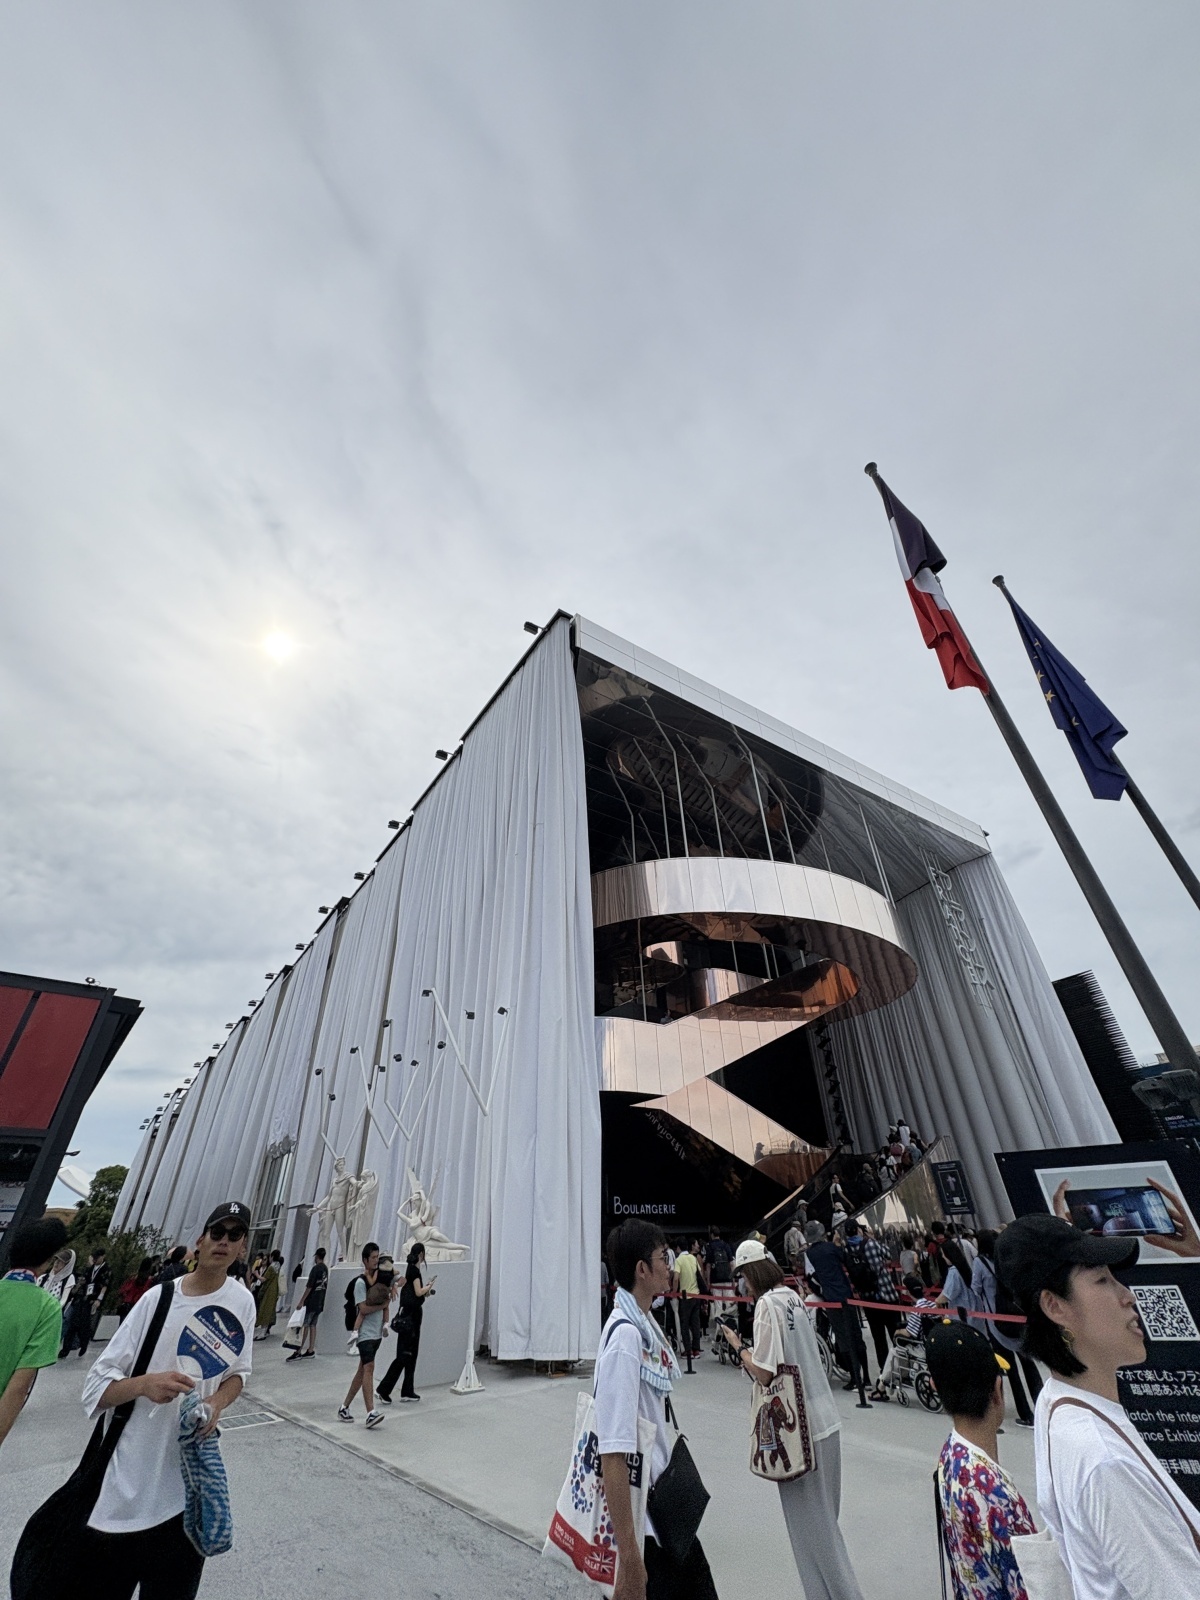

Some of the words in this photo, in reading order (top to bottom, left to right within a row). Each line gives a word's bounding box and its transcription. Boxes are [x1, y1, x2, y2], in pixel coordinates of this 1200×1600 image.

[229, 1202, 240, 1214] LA
[1116, 1370, 1200, 1382] マホで楽しむ、フラ
[1156, 1410, 1175, 1422] the
[1165, 1429, 1200, 1442] Exhibi
[585, 1556, 600, 1570] GREAT
